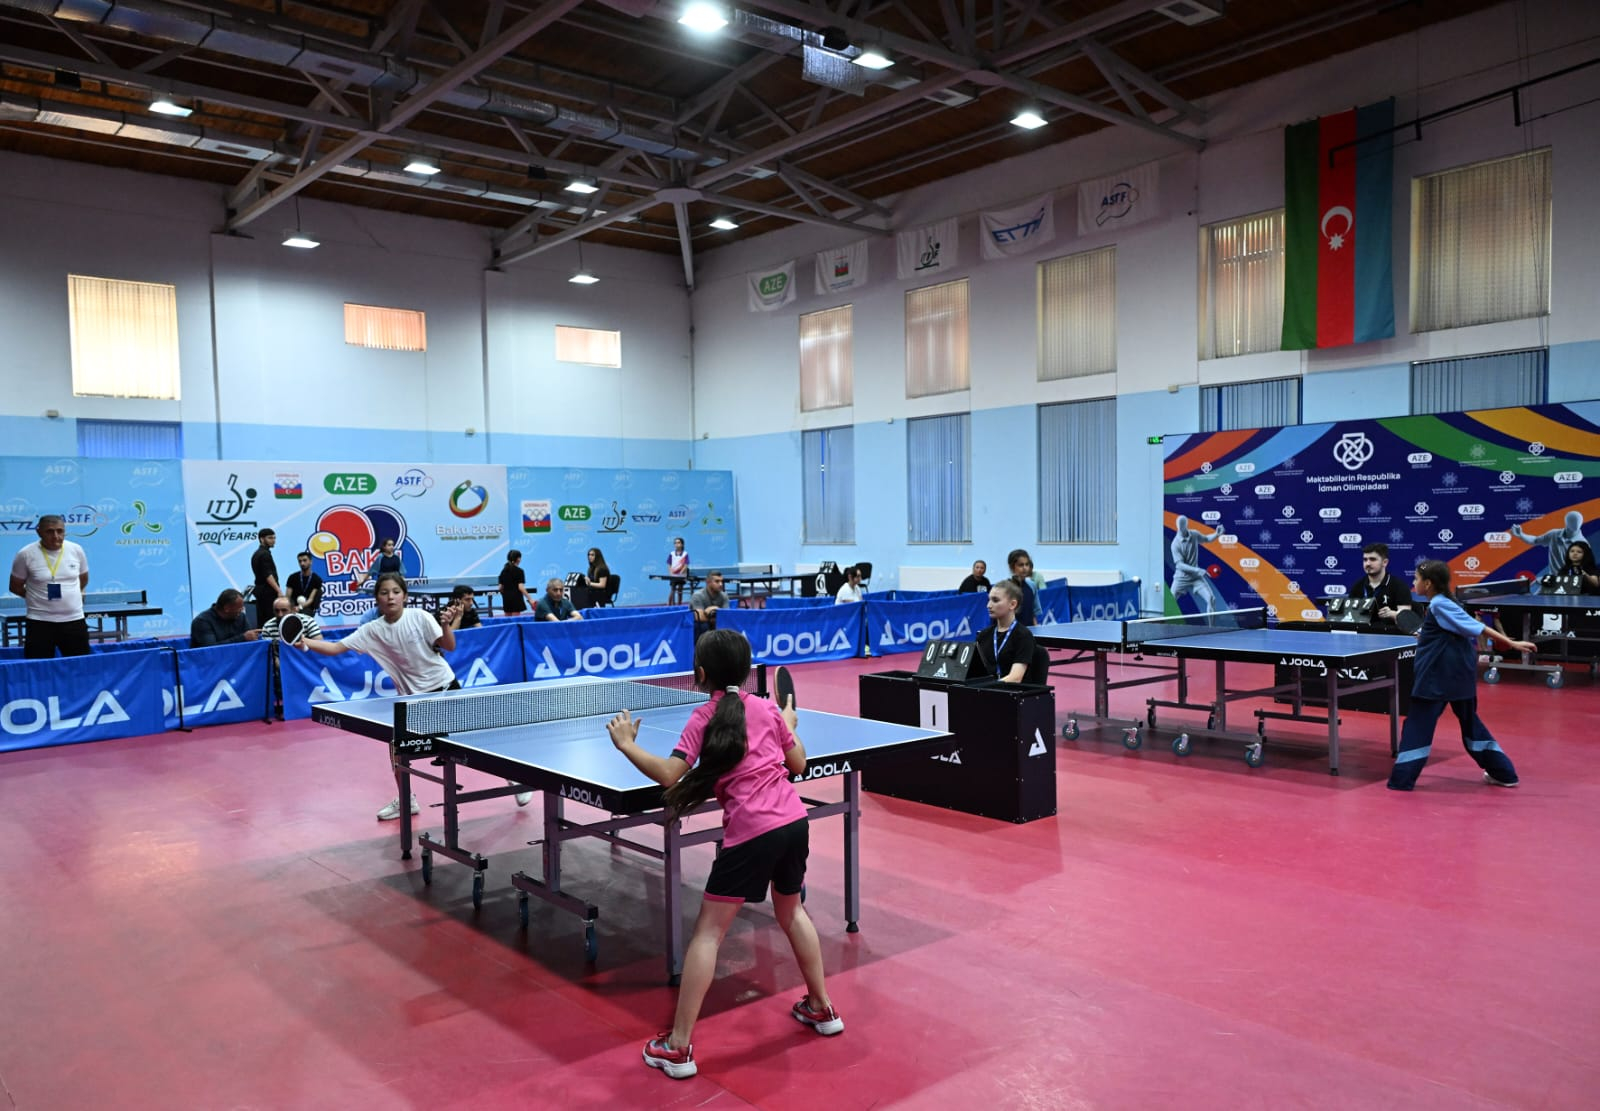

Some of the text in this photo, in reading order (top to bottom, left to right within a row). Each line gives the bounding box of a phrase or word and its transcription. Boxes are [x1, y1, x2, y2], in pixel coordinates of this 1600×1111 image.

[763, 275, 783, 294] AZE
[333, 476, 369, 492] AZE
[395, 476, 422, 486] ASTF
[1357, 472, 1401, 482] Respublika
[206, 500, 256, 514] ITTF
[563, 507, 587, 519] AZE
[668, 510, 687, 519] ASTF
[198, 532, 258, 541] 100 YEARS
[435, 524, 505, 536] Baku 2026
[1086, 600, 1138, 621] JOOLA
[897, 616, 972, 645] JOOLA
[757, 627, 852, 657] JOOLA
[563, 639, 678, 676] JOOLA
[926, 643, 935, 661] 0
[960, 646, 969, 664] 0
[1289, 657, 1326, 668] JOOLA
[406, 738, 432, 747] JOOLA
[805, 760, 853, 780] JOOLA
[567, 785, 604, 808] JOOLA
